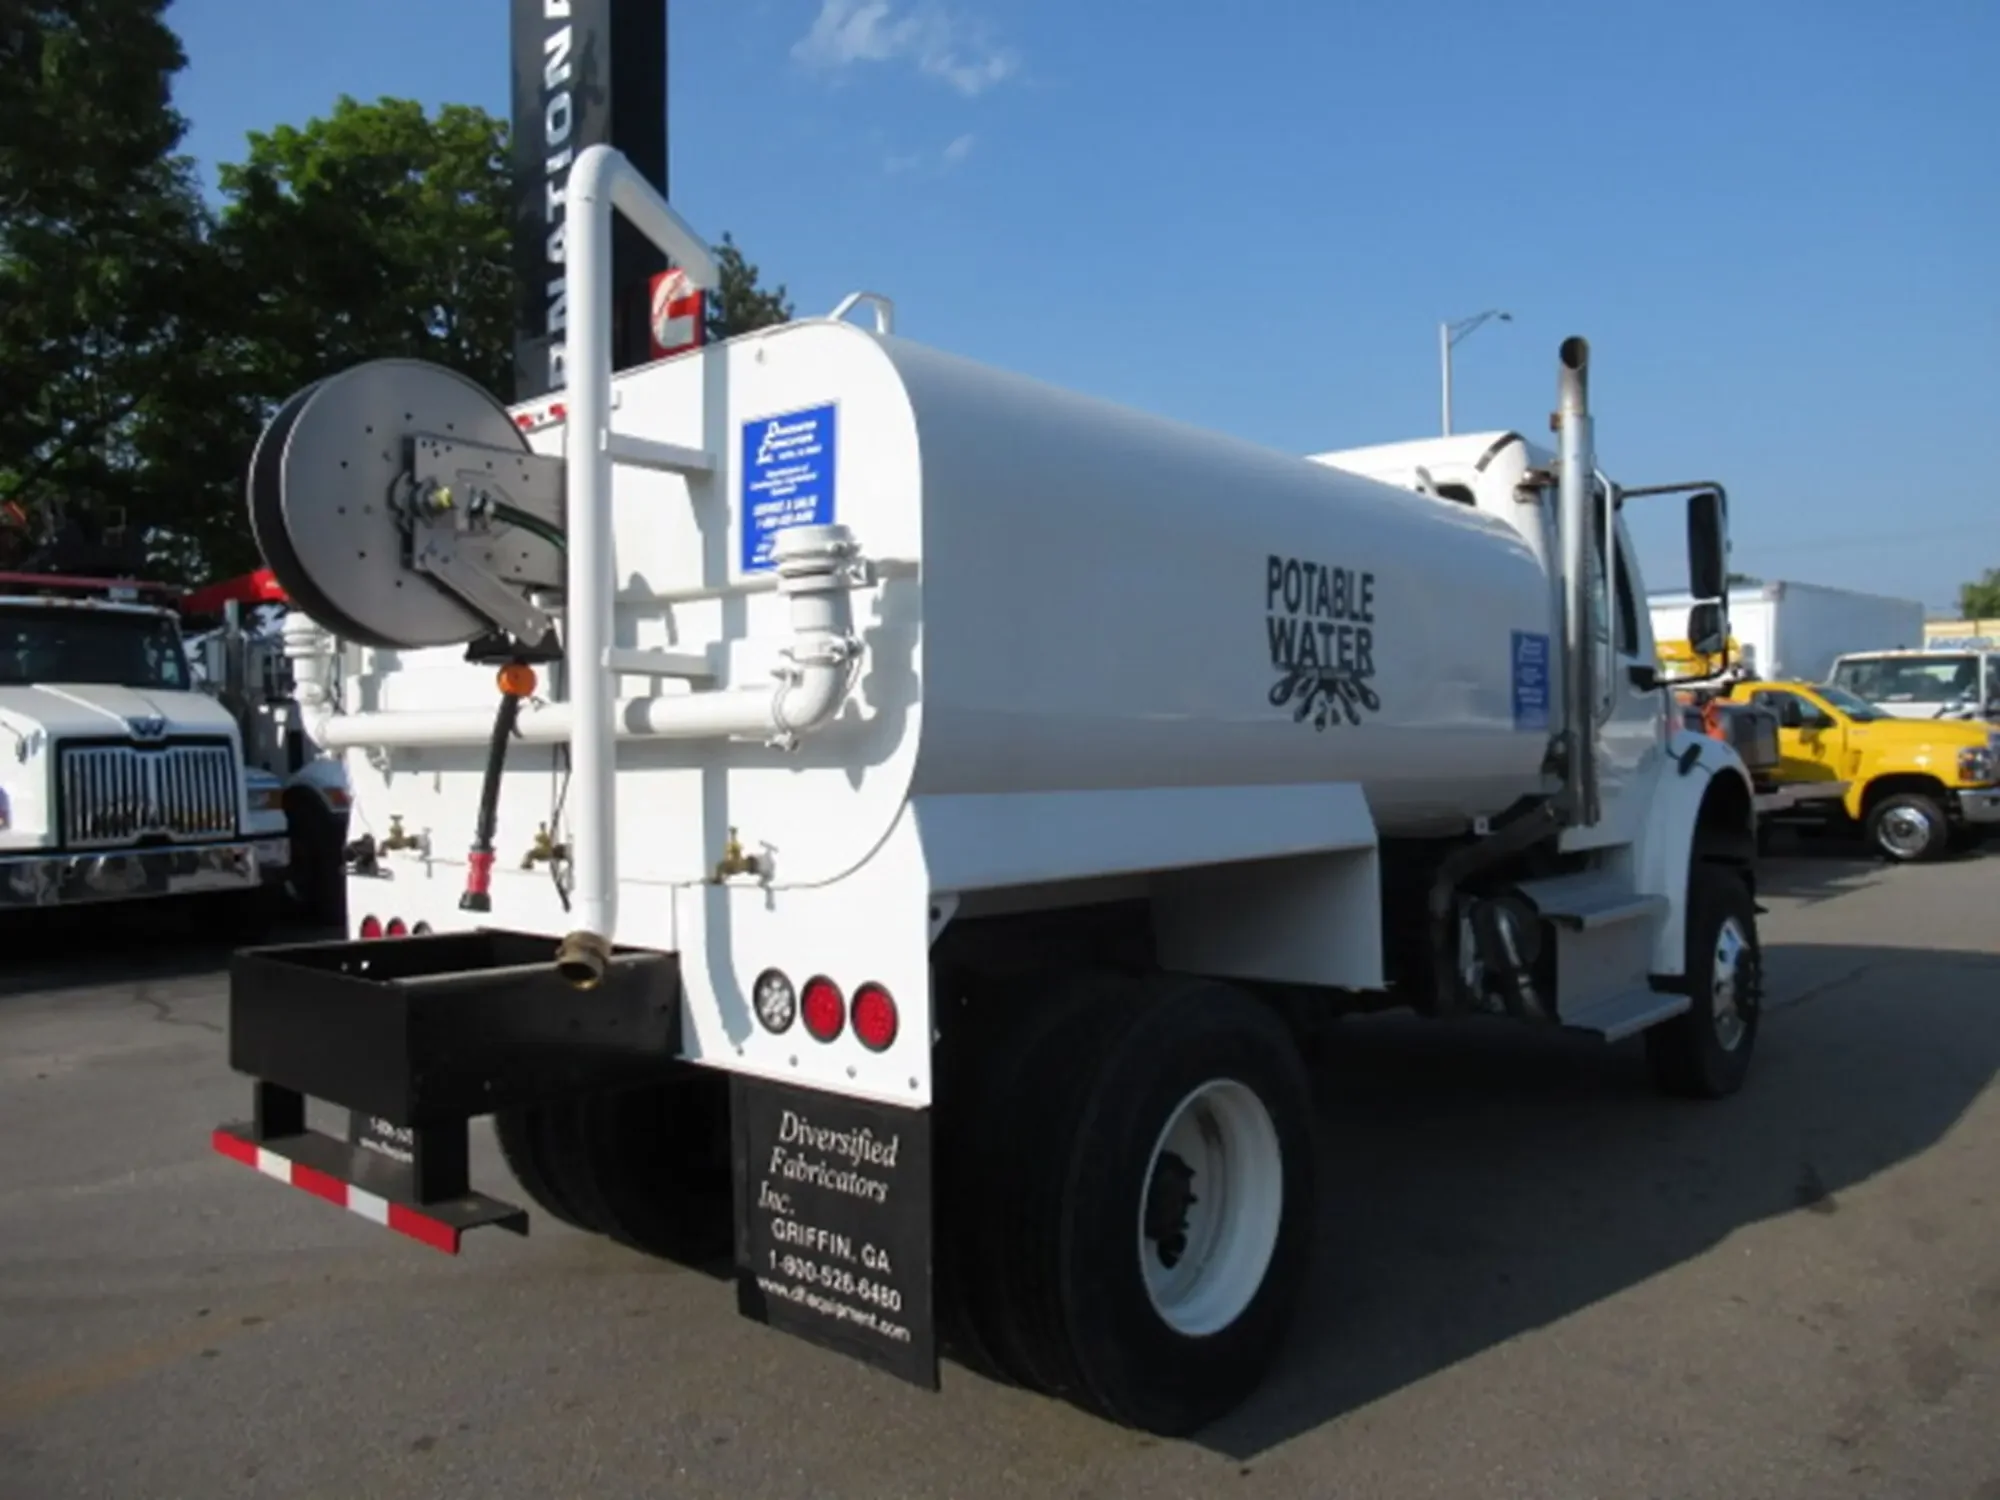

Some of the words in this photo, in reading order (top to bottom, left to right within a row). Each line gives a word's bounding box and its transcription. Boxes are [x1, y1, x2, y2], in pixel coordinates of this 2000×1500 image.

[1267, 554, 1375, 624] POTABLE
[1267, 615, 1375, 679] WATER
[779, 1110, 899, 1168] Diversified
[758, 1180, 795, 1215] Inc.
[769, 1146, 889, 1204] Fabricators
[861, 1242, 892, 1274] GA
